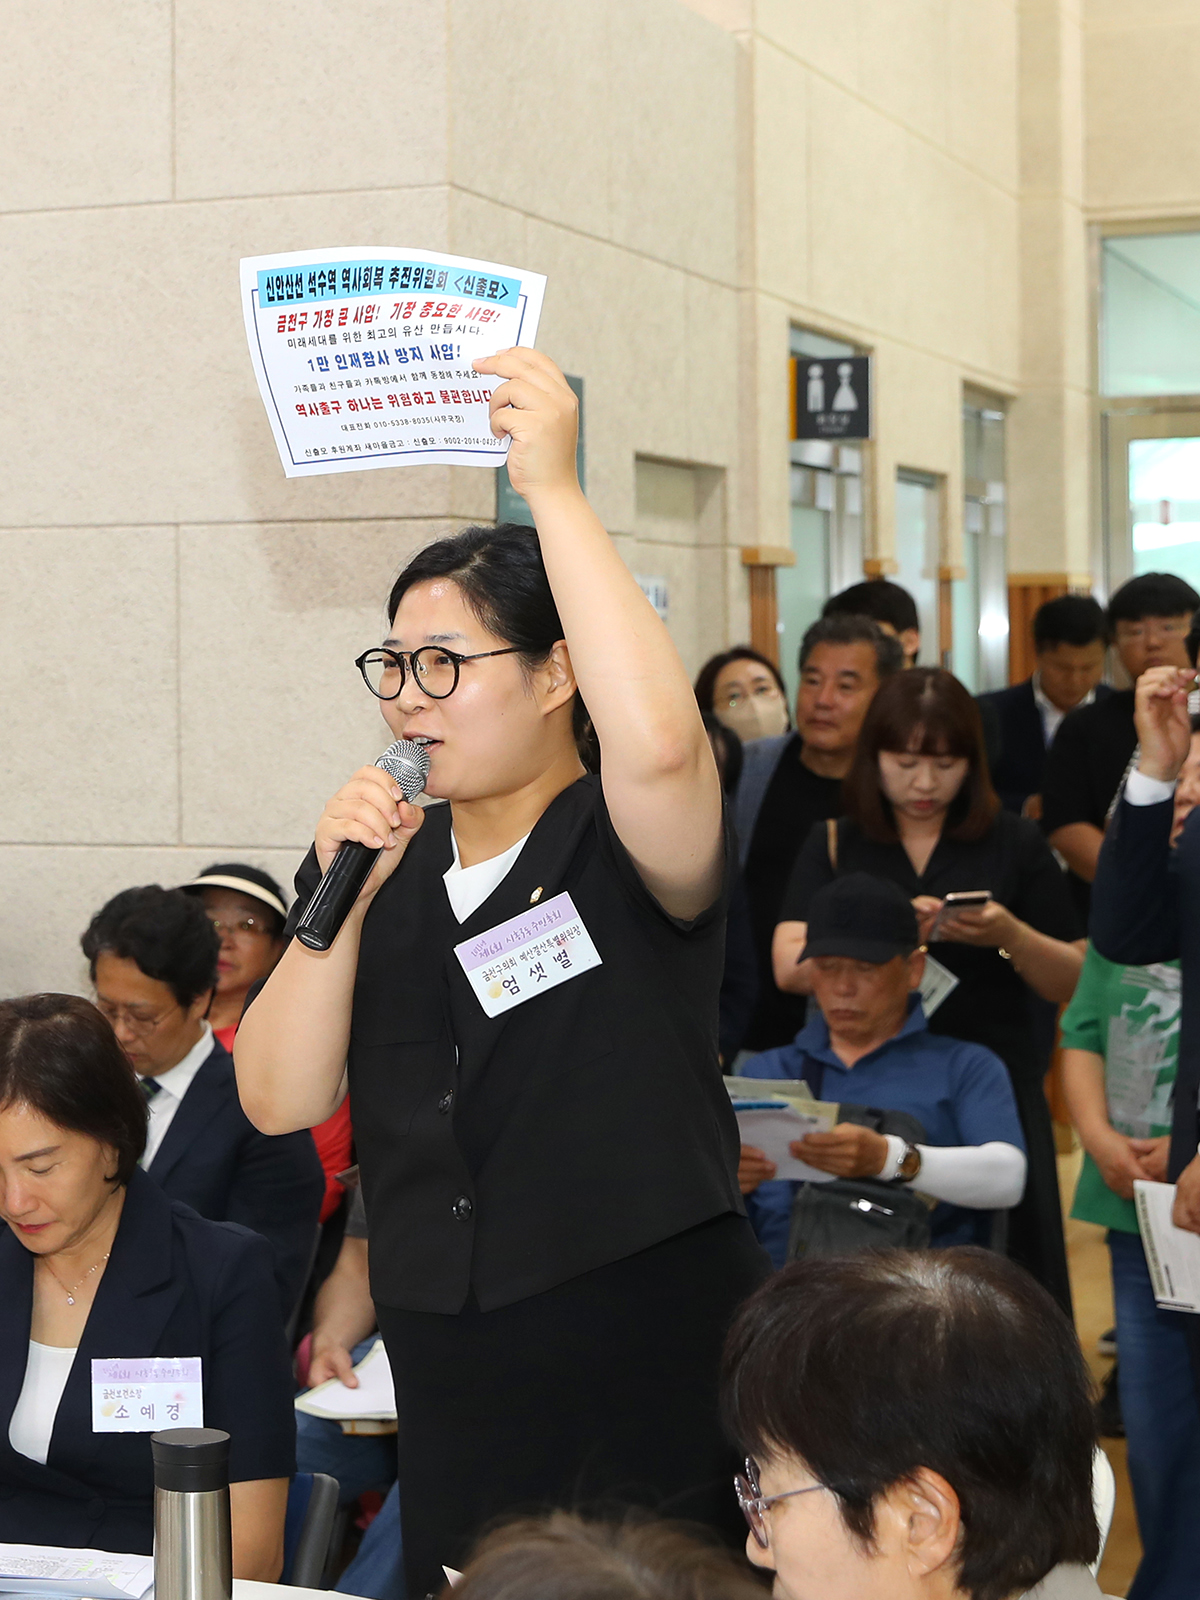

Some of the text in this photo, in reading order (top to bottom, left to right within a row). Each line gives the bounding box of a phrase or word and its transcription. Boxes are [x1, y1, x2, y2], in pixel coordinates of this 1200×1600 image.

[266, 273, 303, 302] 신안산선
[308, 269, 336, 297] 석수역
[342, 266, 384, 293] 역사회복
[389, 266, 448, 291] 추진위원회
[277, 312, 308, 333] 금천구
[338, 307, 349, 326] 큰
[353, 304, 381, 324] 사업!
[419, 301, 463, 319] 중요한
[465, 304, 501, 323] 사업!
[287, 334, 337, 349] 미래세대를
[342, 331, 362, 343] 위한
[367, 327, 397, 340] 최고의
[403, 324, 423, 337] 유산
[308, 343, 460, 372] 1만 인재참사 방지 사업!
[295, 400, 342, 417] 역사출구
[347, 397, 383, 412] 하나는
[387, 391, 436, 407] 위험하고
[482, 957, 518, 982] 금천구의회
